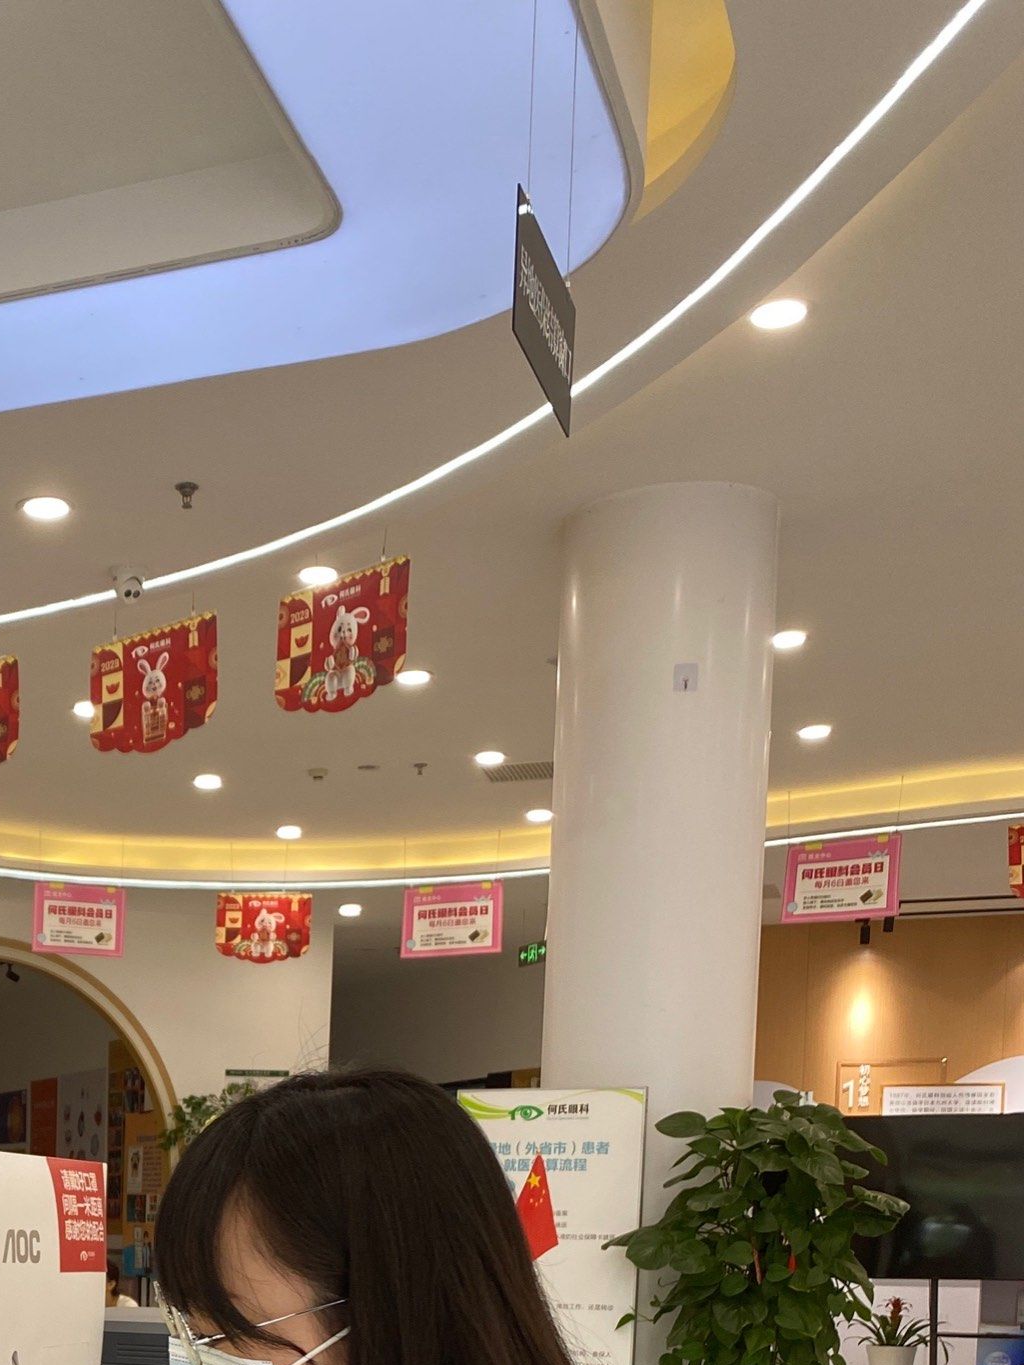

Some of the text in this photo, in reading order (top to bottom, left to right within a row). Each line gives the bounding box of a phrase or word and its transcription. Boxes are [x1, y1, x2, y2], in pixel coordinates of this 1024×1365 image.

[547, 1104, 590, 1116] 何氏眼科
[503, 1158, 588, 1172] 就医算流程
[2, 1228, 41, 1264] AOC
